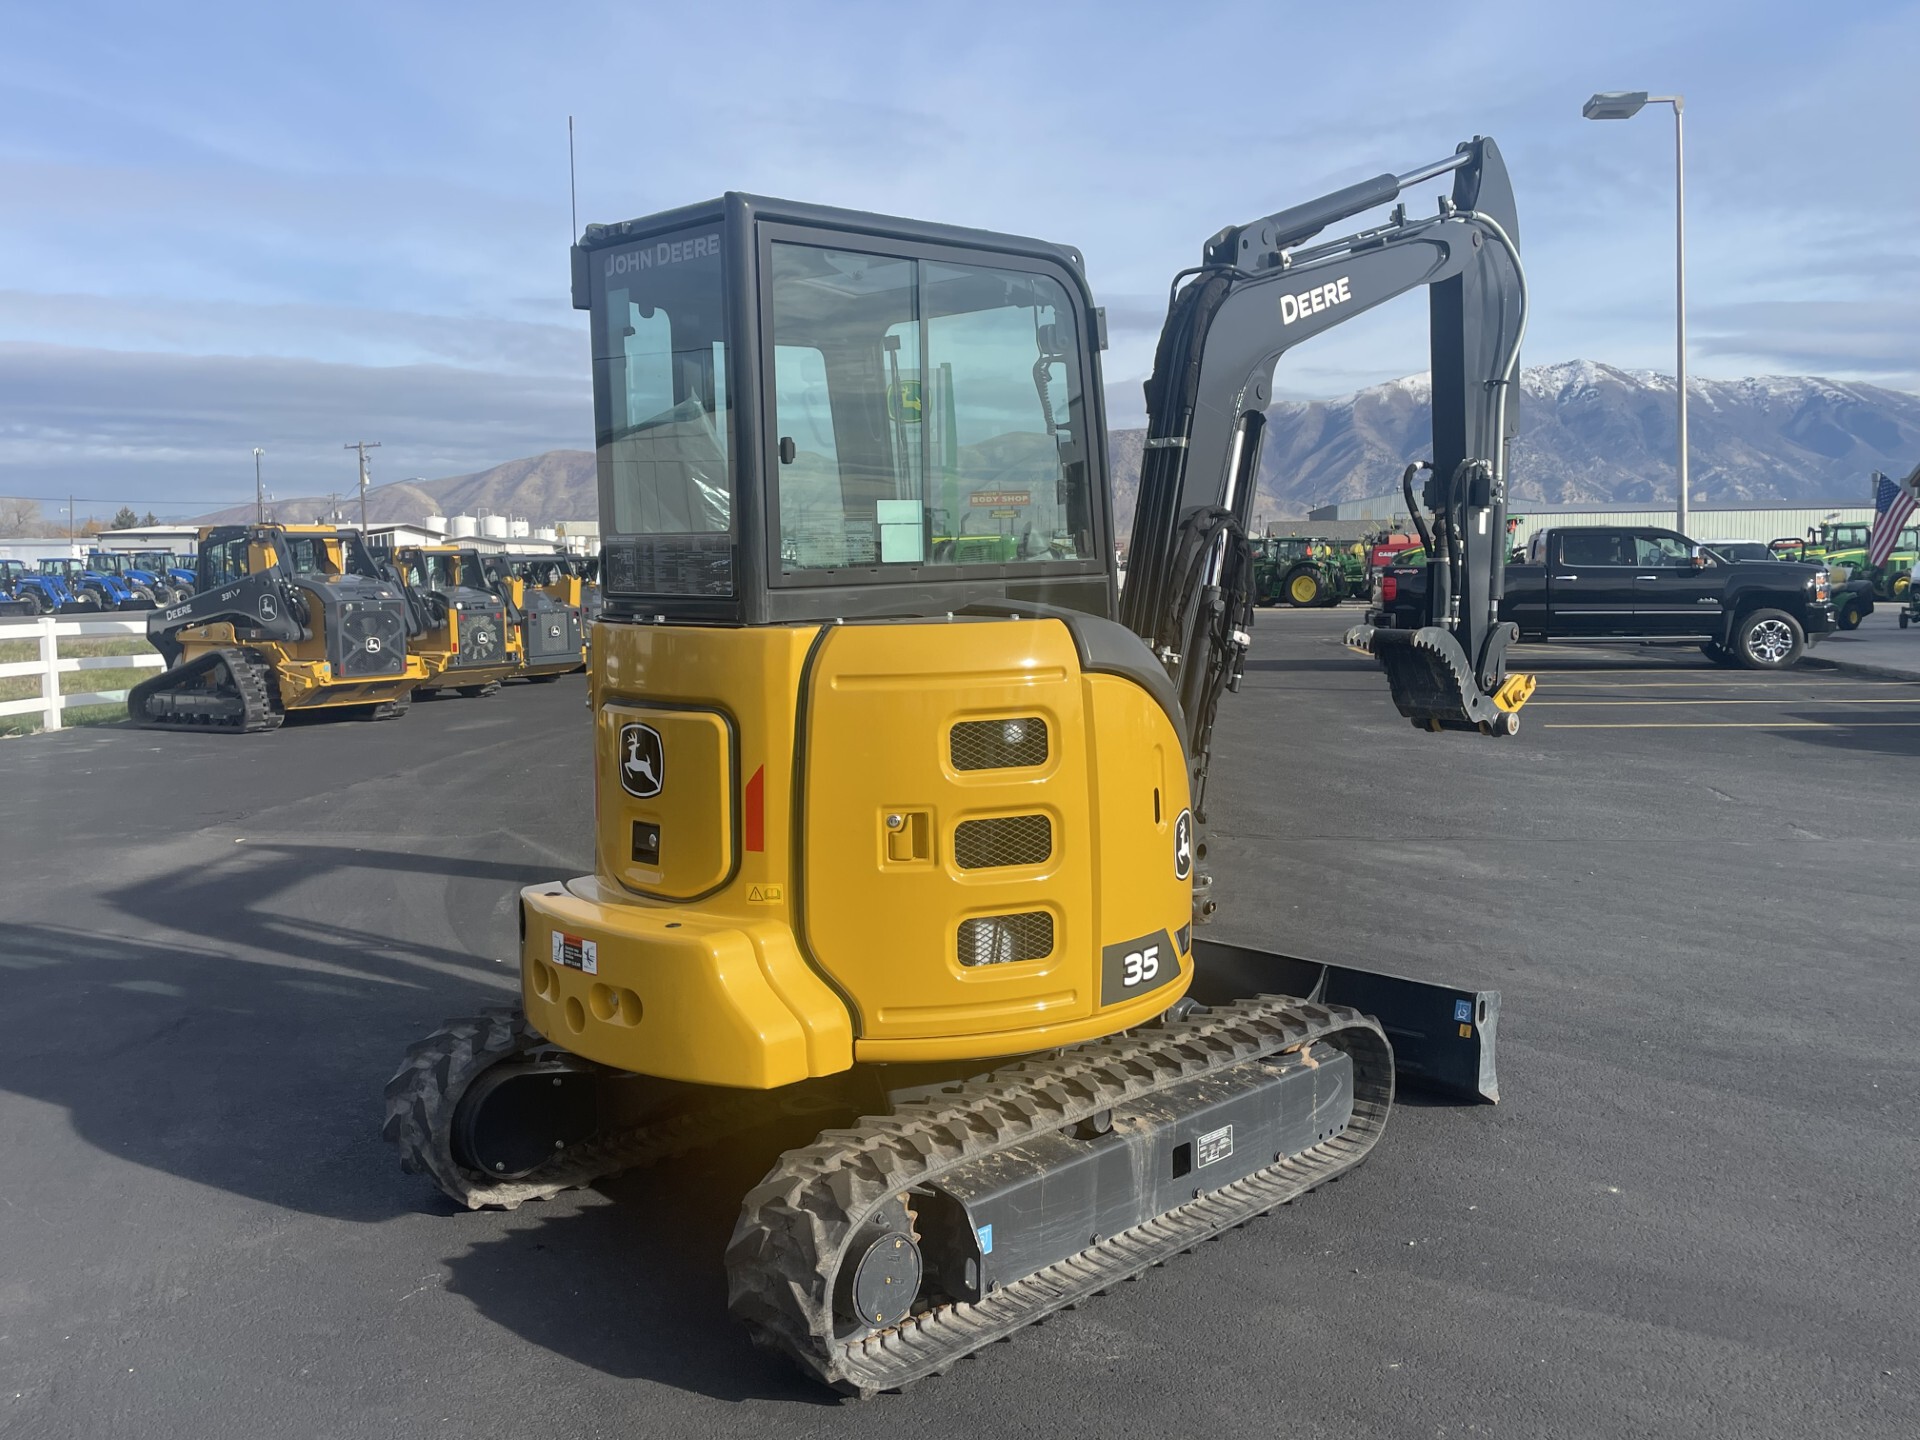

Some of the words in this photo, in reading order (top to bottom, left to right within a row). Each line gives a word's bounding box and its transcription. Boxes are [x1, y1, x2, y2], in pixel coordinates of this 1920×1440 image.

[605, 249, 653, 277] JOHN
[656, 234, 720, 266] DEERE
[1280, 276, 1352, 326] DEERE
[971, 496, 999, 504] BODY
[1001, 495, 1029, 503] SHOP
[166, 603, 193, 621] DEERE
[1122, 944, 1160, 987] 35
